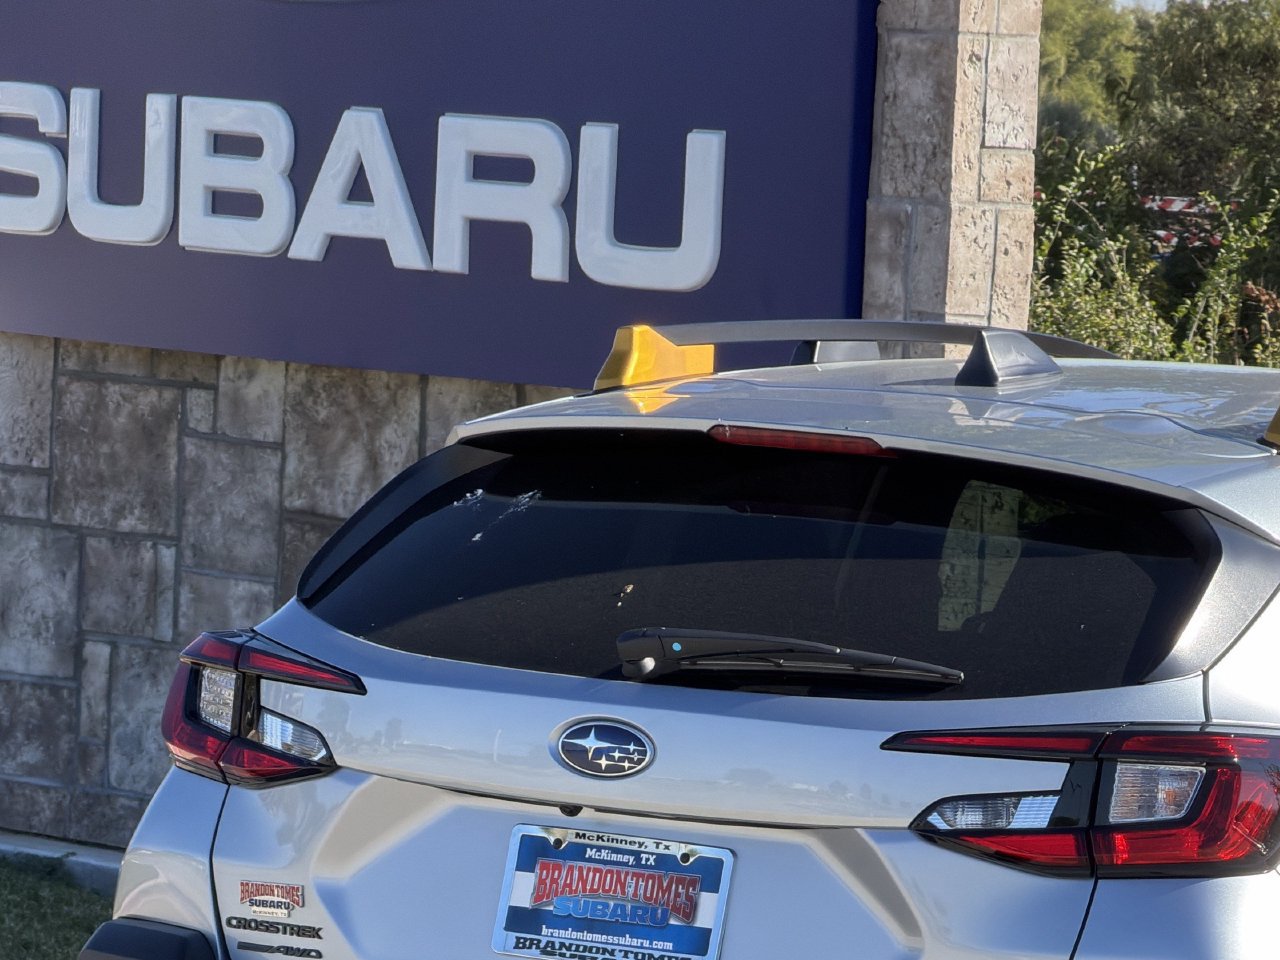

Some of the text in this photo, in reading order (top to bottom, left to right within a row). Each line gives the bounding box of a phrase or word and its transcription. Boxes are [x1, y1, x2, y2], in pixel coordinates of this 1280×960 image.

[0, 81, 726, 292] SUBARU
[575, 832, 672, 851] McKinney, Tx
[585, 848, 656, 866] McKinney, TX
[240, 881, 301, 907] BRANDON TOMES
[532, 860, 699, 921] BRANDON TOMES
[249, 898, 291, 910] SUBARU
[553, 896, 671, 927] SUBARU
[226, 916, 323, 940] CROSSTREK
[541, 925, 673, 950] brandontomessubaru.com
[266, 945, 323, 959] AWD
[513, 936, 616, 957] BRANDON
